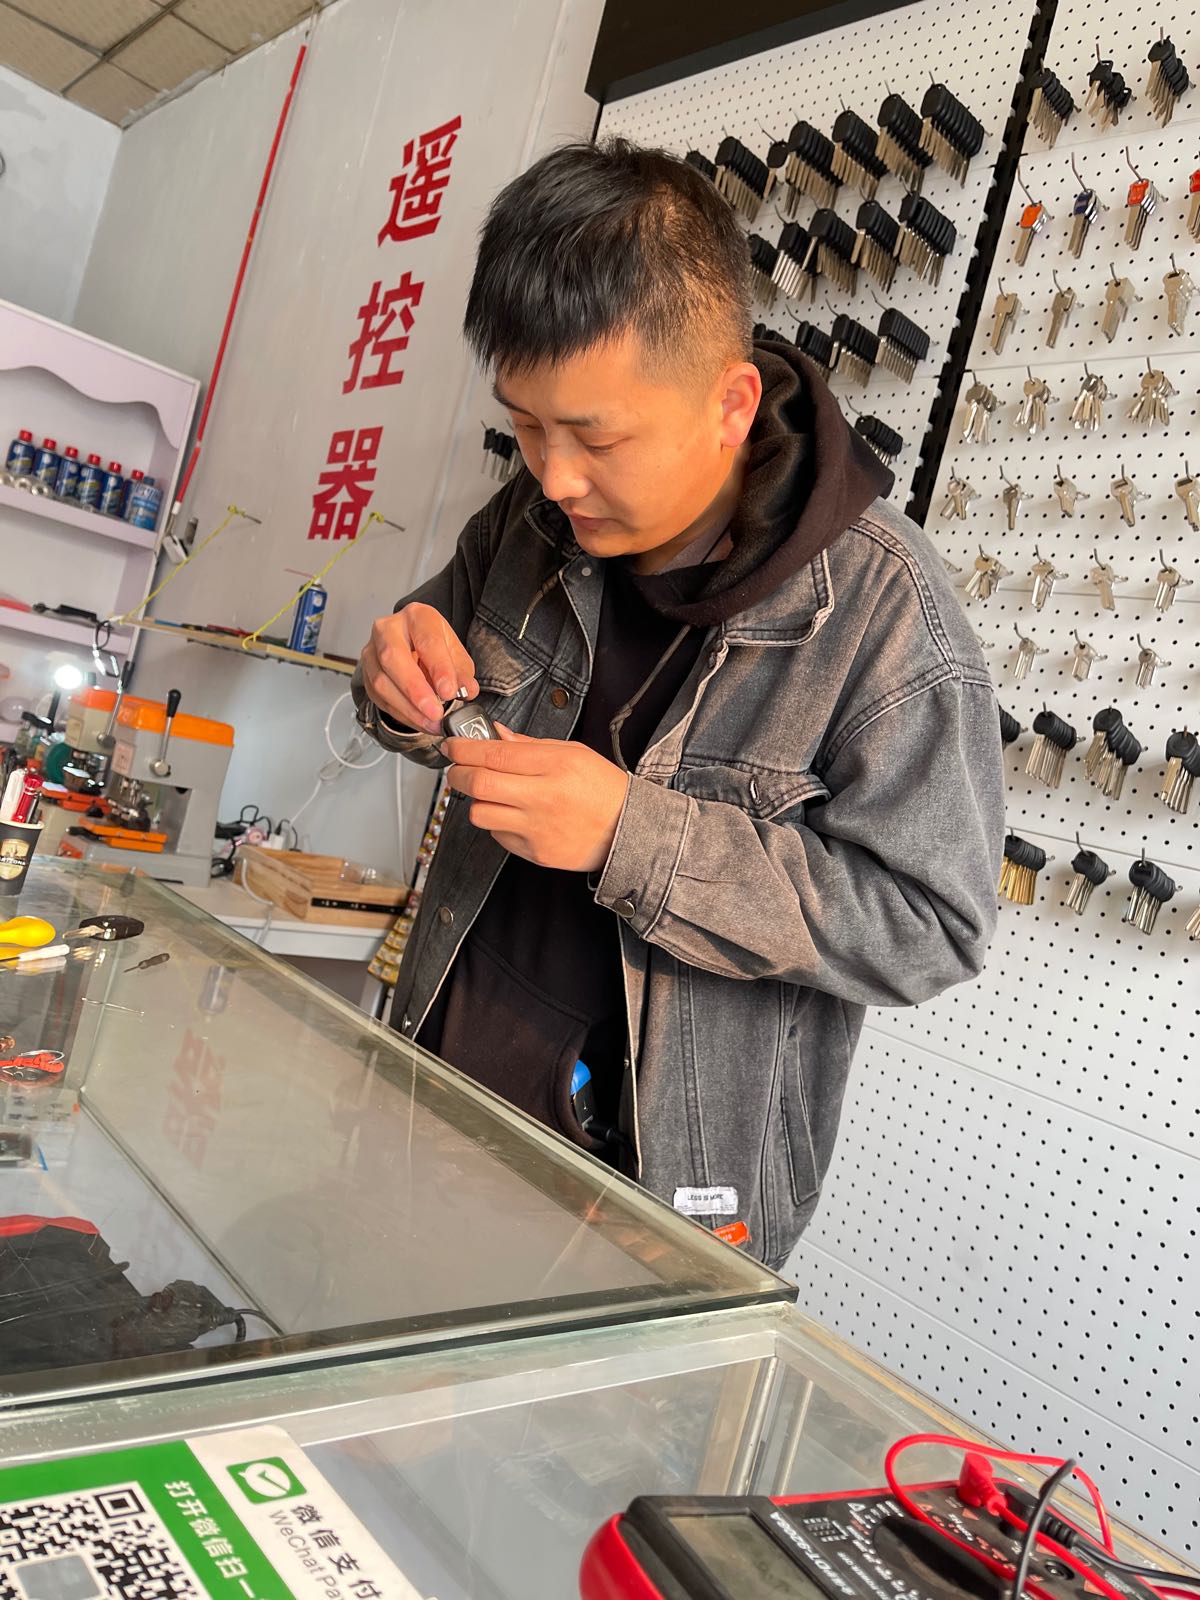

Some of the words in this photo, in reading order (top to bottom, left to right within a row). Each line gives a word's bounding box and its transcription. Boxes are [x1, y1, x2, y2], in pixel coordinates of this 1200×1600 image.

[307, 115, 462, 540] 遥控器
[164, 1480, 267, 1600] 打开微信扫一
[269, 1509, 325, 1575] WeChat
[315, 1574, 343, 1600] Pa
[290, 1504, 383, 1600] 微信支付
